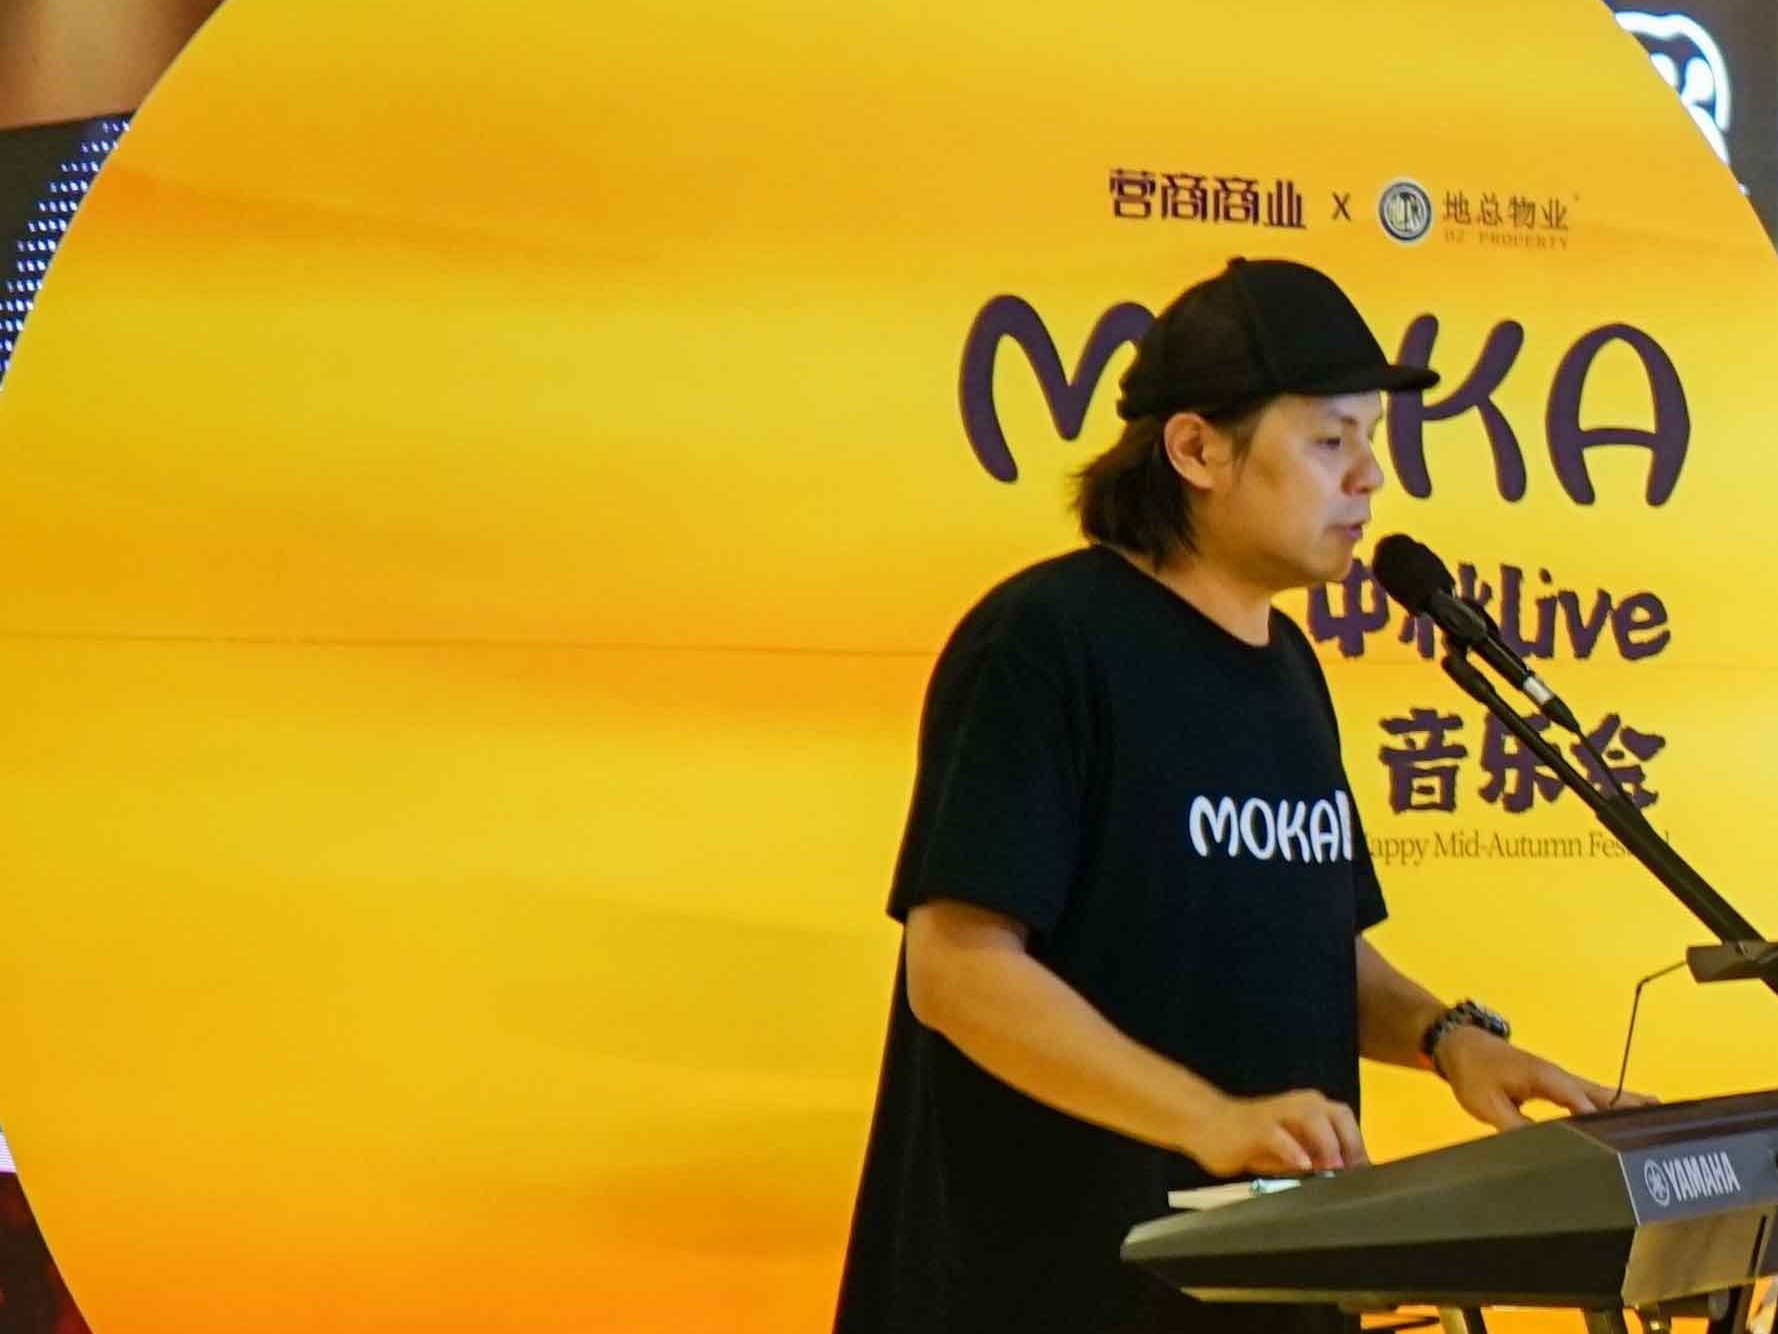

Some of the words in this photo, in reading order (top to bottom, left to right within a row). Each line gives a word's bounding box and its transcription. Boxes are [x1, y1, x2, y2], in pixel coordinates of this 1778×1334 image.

[1109, 167, 1308, 231] 营商商业
[1442, 189, 1569, 231] 地总物业
[958, 293, 1692, 508] MKA
[1365, 833, 1428, 866] appy
[1433, 830, 1583, 860] Mid-Autumn
[1661, 1151, 1741, 1202] YAMAHA
